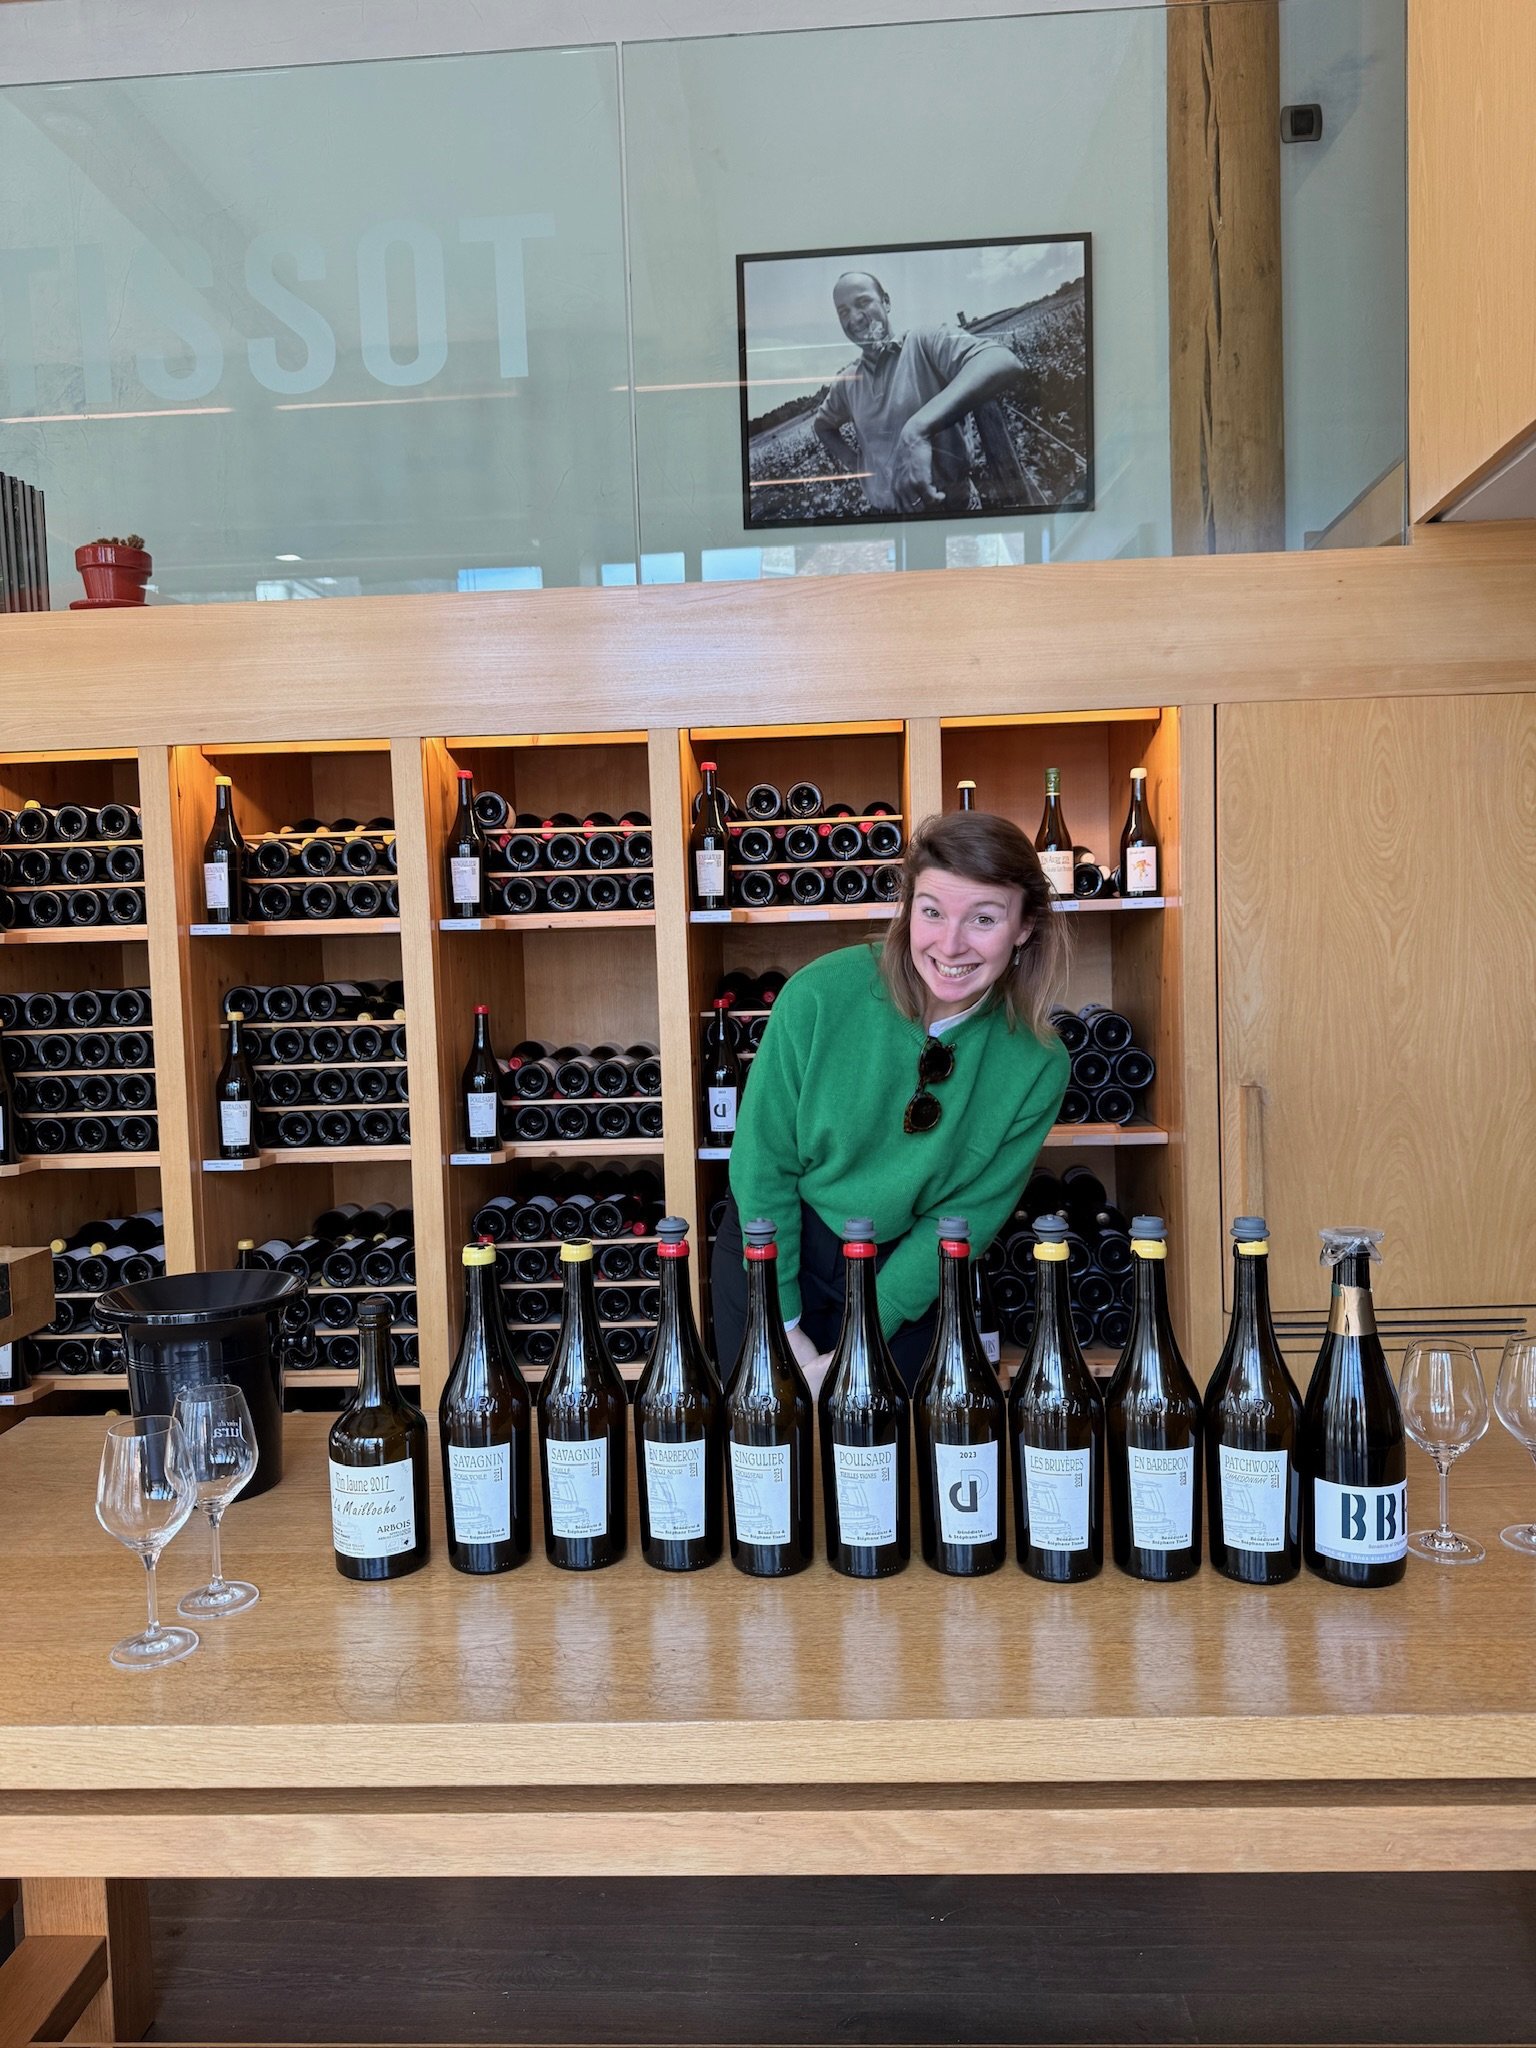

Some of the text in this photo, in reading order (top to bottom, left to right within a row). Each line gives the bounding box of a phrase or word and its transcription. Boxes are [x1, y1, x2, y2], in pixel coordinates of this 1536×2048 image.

[454, 1452, 504, 1468] SAVAGNIN
[552, 1446, 601, 1462] SAVAGNIN
[649, 1448, 700, 1462] EN BARBERON
[734, 1450, 784, 1467] SINGULIER
[840, 1451, 892, 1467] POULSARD
[960, 1451, 977, 1459] 2023
[1030, 1455, 1084, 1472] LES BRUYÈRES
[1134, 1456, 1189, 1472] EN BARBERON
[1224, 1454, 1280, 1473] PATCHWORK
[370, 1476, 390, 1492] 2017
[376, 1520, 411, 1534] ARBOIS
